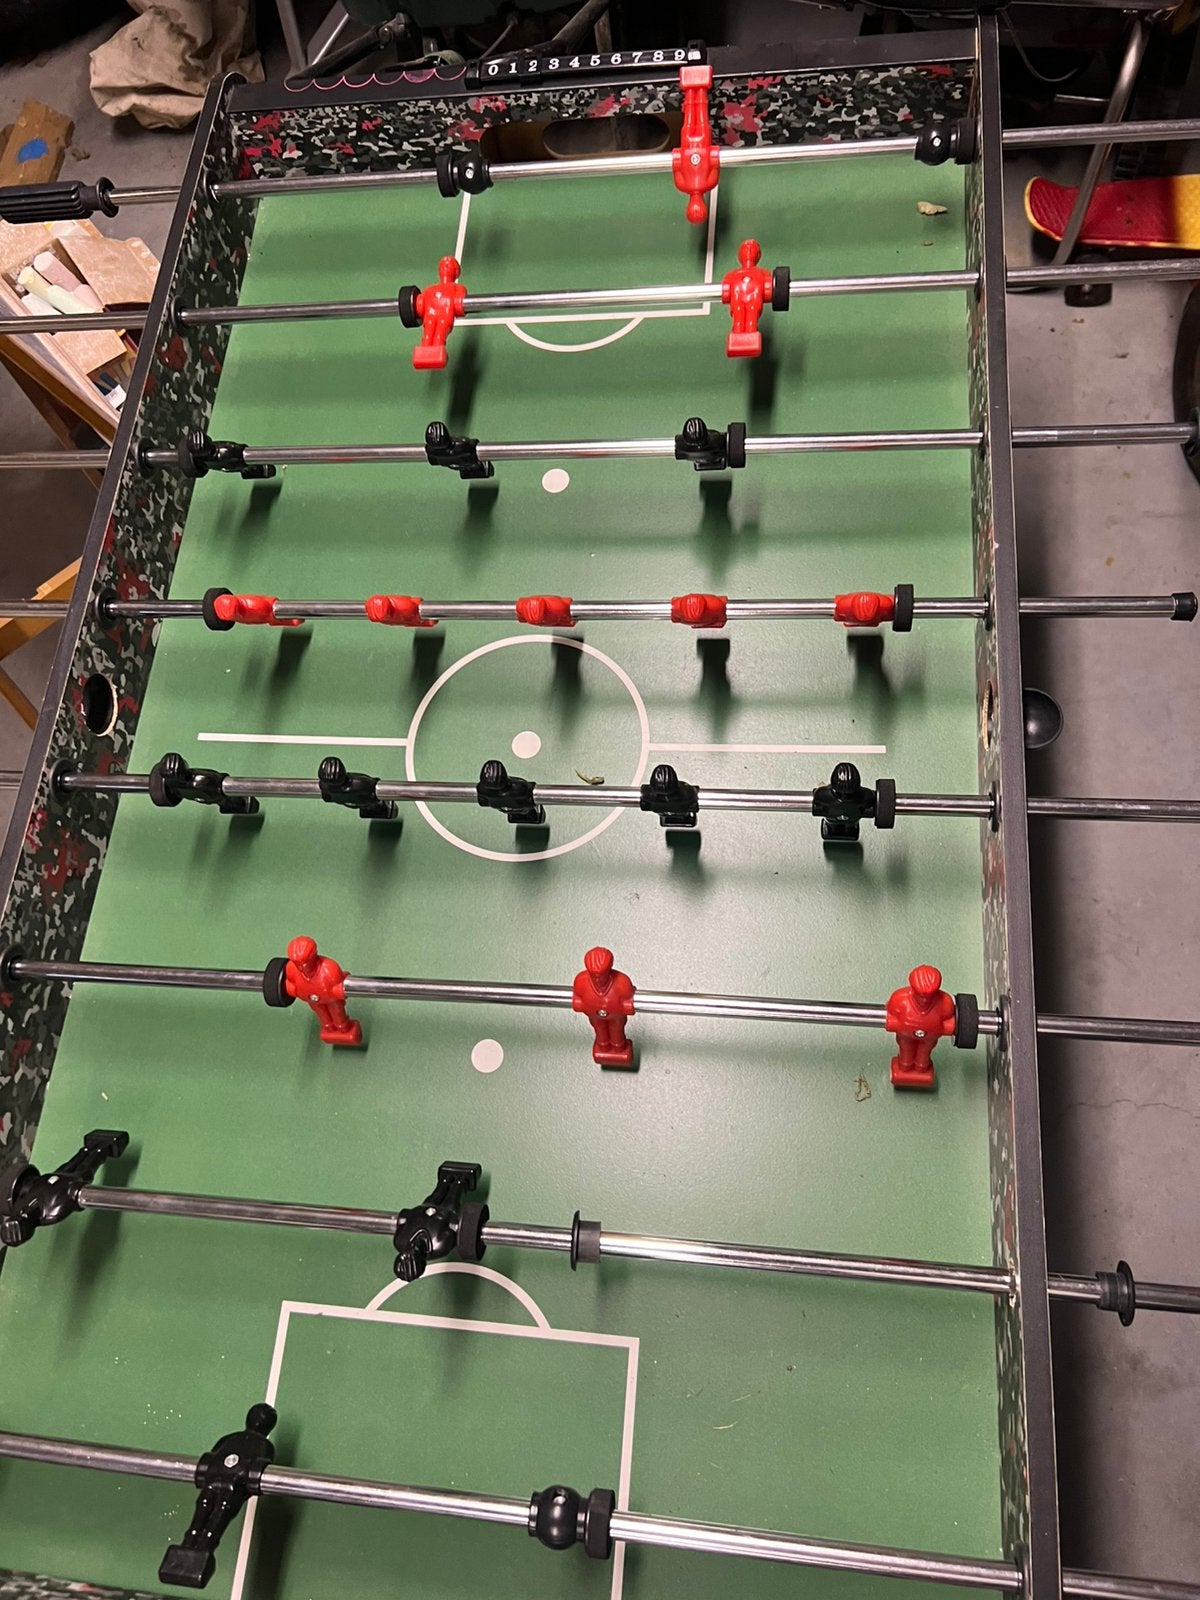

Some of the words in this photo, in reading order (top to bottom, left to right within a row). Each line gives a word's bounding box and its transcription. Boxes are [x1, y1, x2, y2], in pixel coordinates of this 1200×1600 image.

[488, 64, 499, 76] 0
[508, 62, 518, 74] 1
[528, 60, 538, 72] 2
[548, 58, 560, 70] 3
[569, 56, 580, 69] 4
[590, 54, 601, 67] 5
[610, 53, 622, 65] 6
[632, 51, 643, 63] 7
[652, 50, 664, 62] 8
[674, 49, 686, 61] 9
